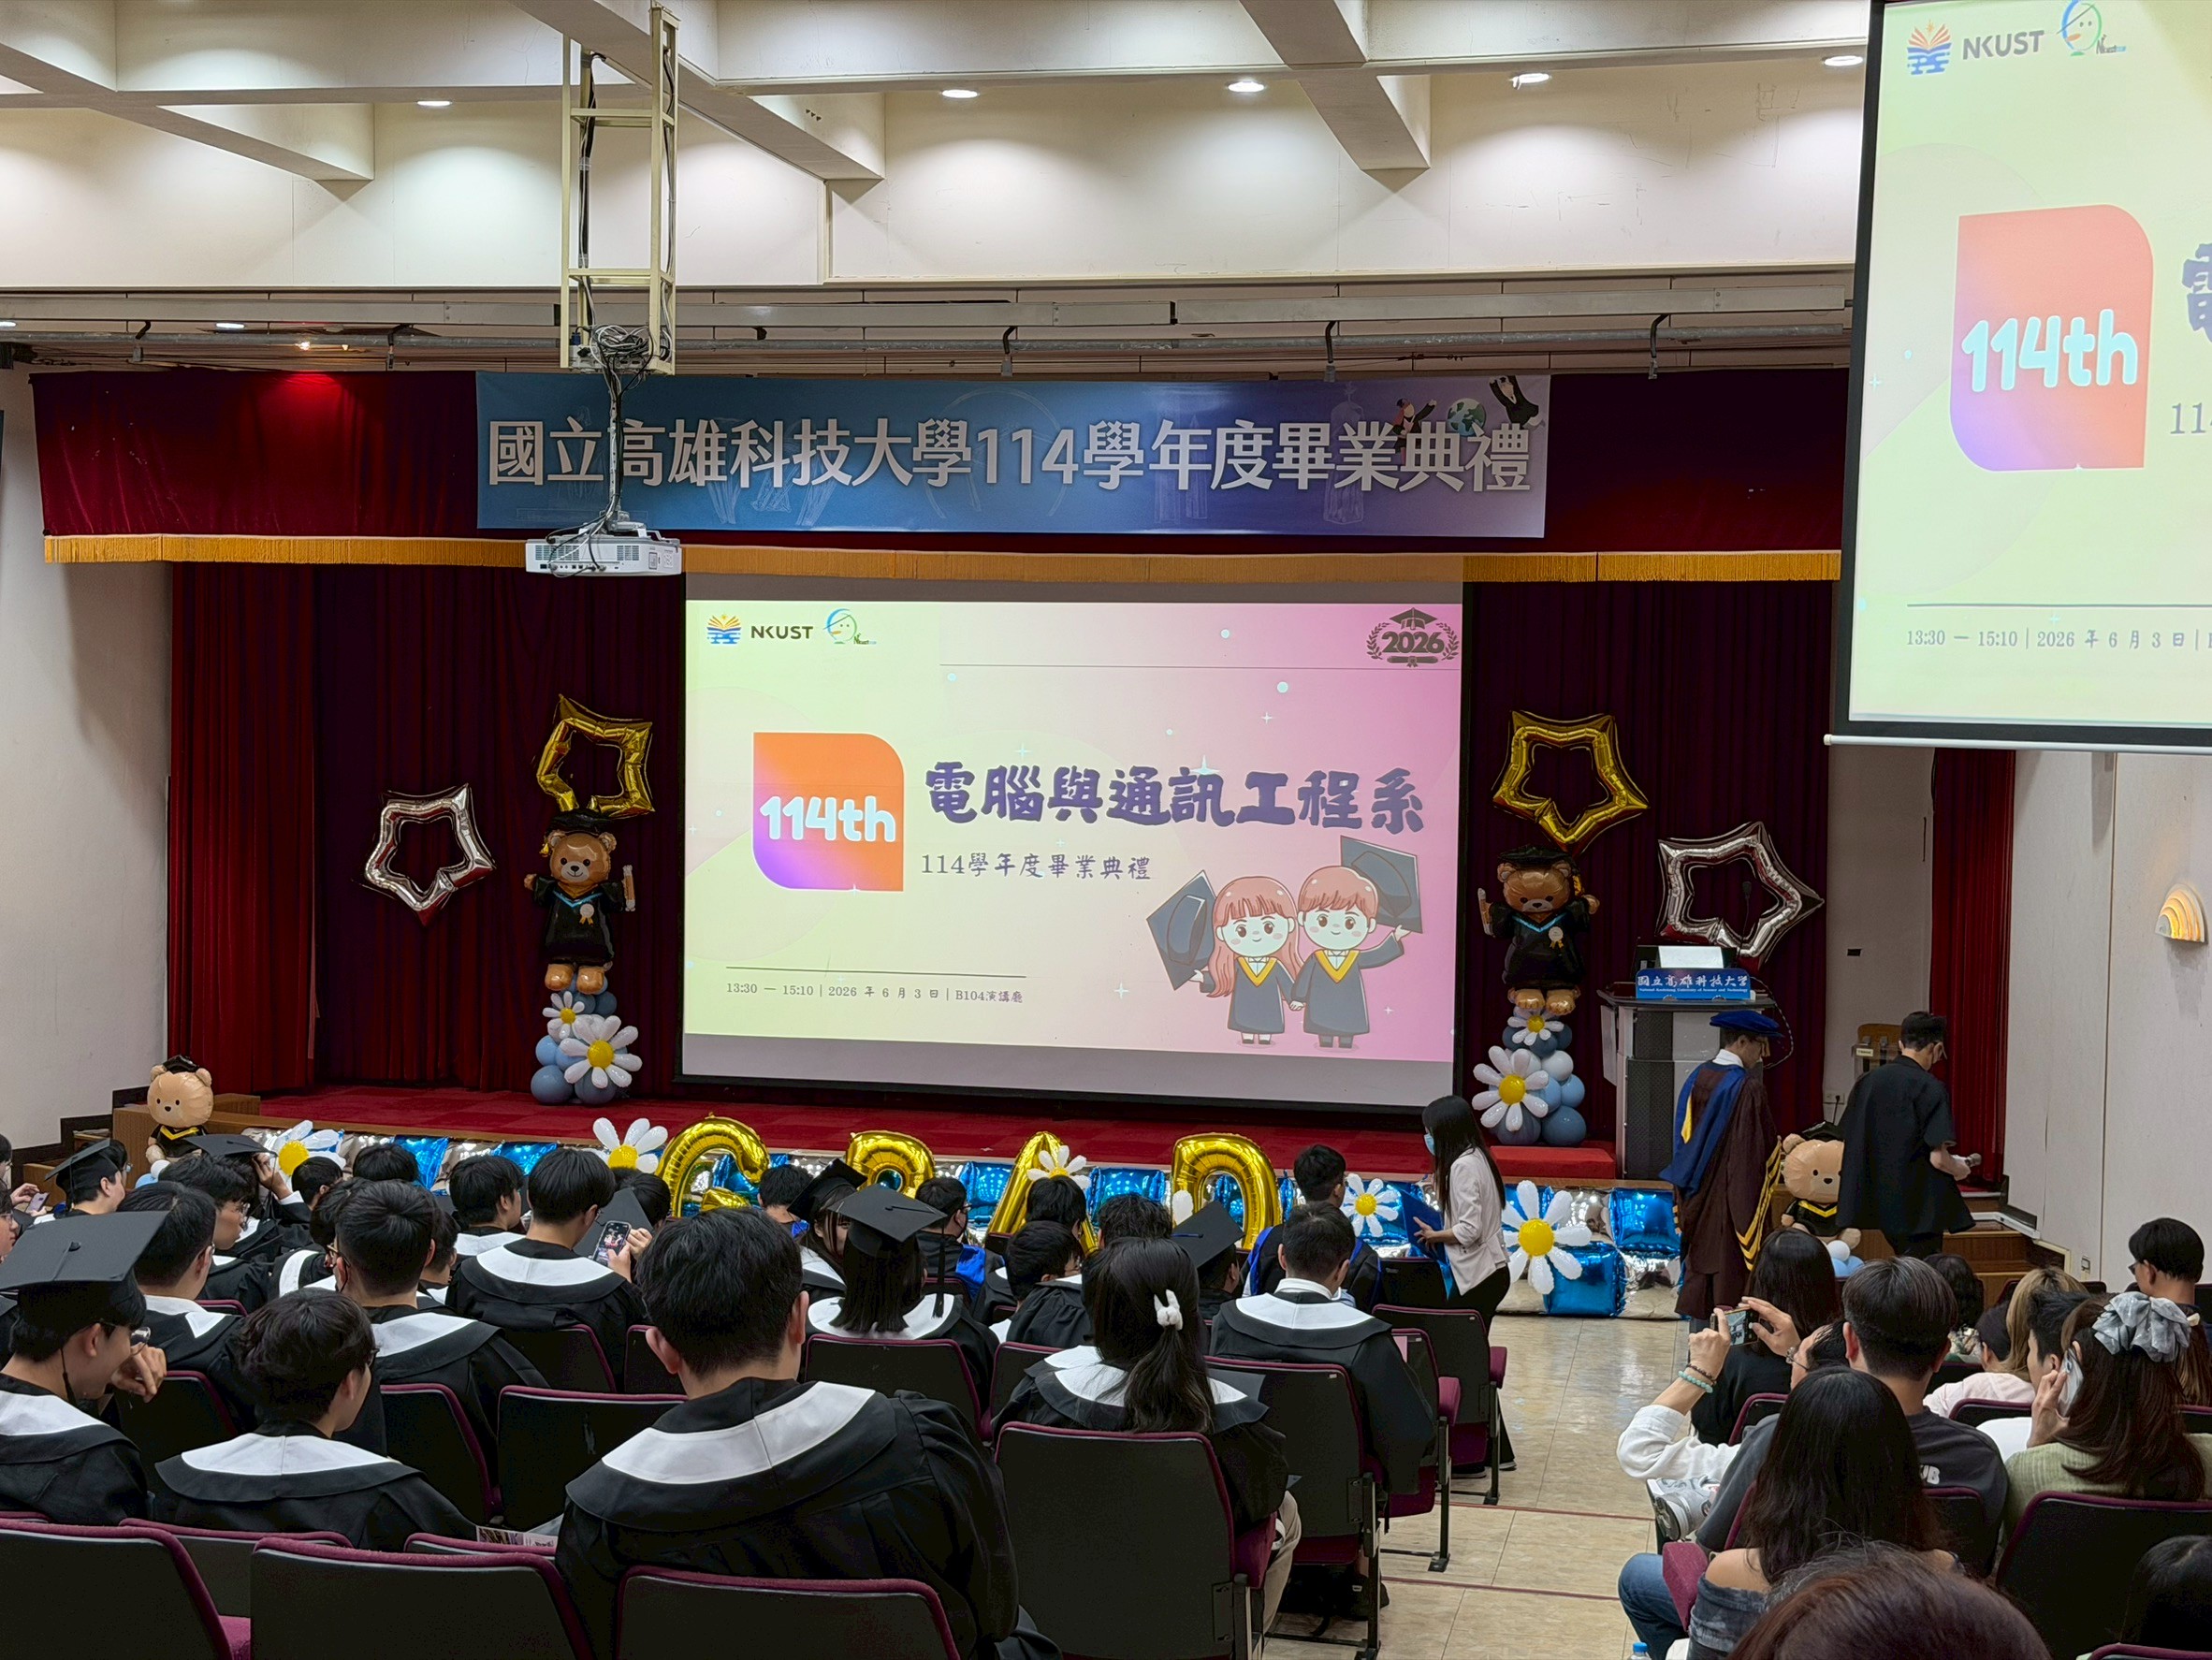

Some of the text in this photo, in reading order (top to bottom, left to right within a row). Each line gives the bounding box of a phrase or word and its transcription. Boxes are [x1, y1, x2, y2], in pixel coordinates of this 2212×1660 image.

[1963, 30, 2045, 60] NKUST
[1961, 309, 2138, 392] 114th
[2170, 402, 2212, 434] 11
[488, 416, 1531, 493] 國立高雄科技大學114學年度畢業典禮
[751, 625, 814, 640] NKUST
[1381, 631, 1445, 654] 2026
[1907, 630, 1945, 646] 13:30
[1978, 631, 2018, 647] 15:10
[2037, 632, 2075, 648] 2026
[2108, 632, 2117, 648] 6
[2129, 630, 2140, 648] 月
[2151, 633, 2161, 648] 3
[2172, 632, 2185, 648] 日
[925, 761, 1424, 834] 電腦與通訊工程系
[760, 795, 896, 842] 114th
[922, 852, 1151, 881] 114學年度畢業典禮
[726, 983, 758, 994] 13:30
[783, 985, 814, 996] 15:10
[828, 986, 857, 997] 2026
[881, 987, 889, 998] 6
[897, 987, 906, 998] 月
[914, 989, 922, 999] 3
[929, 989, 939, 998] 日
